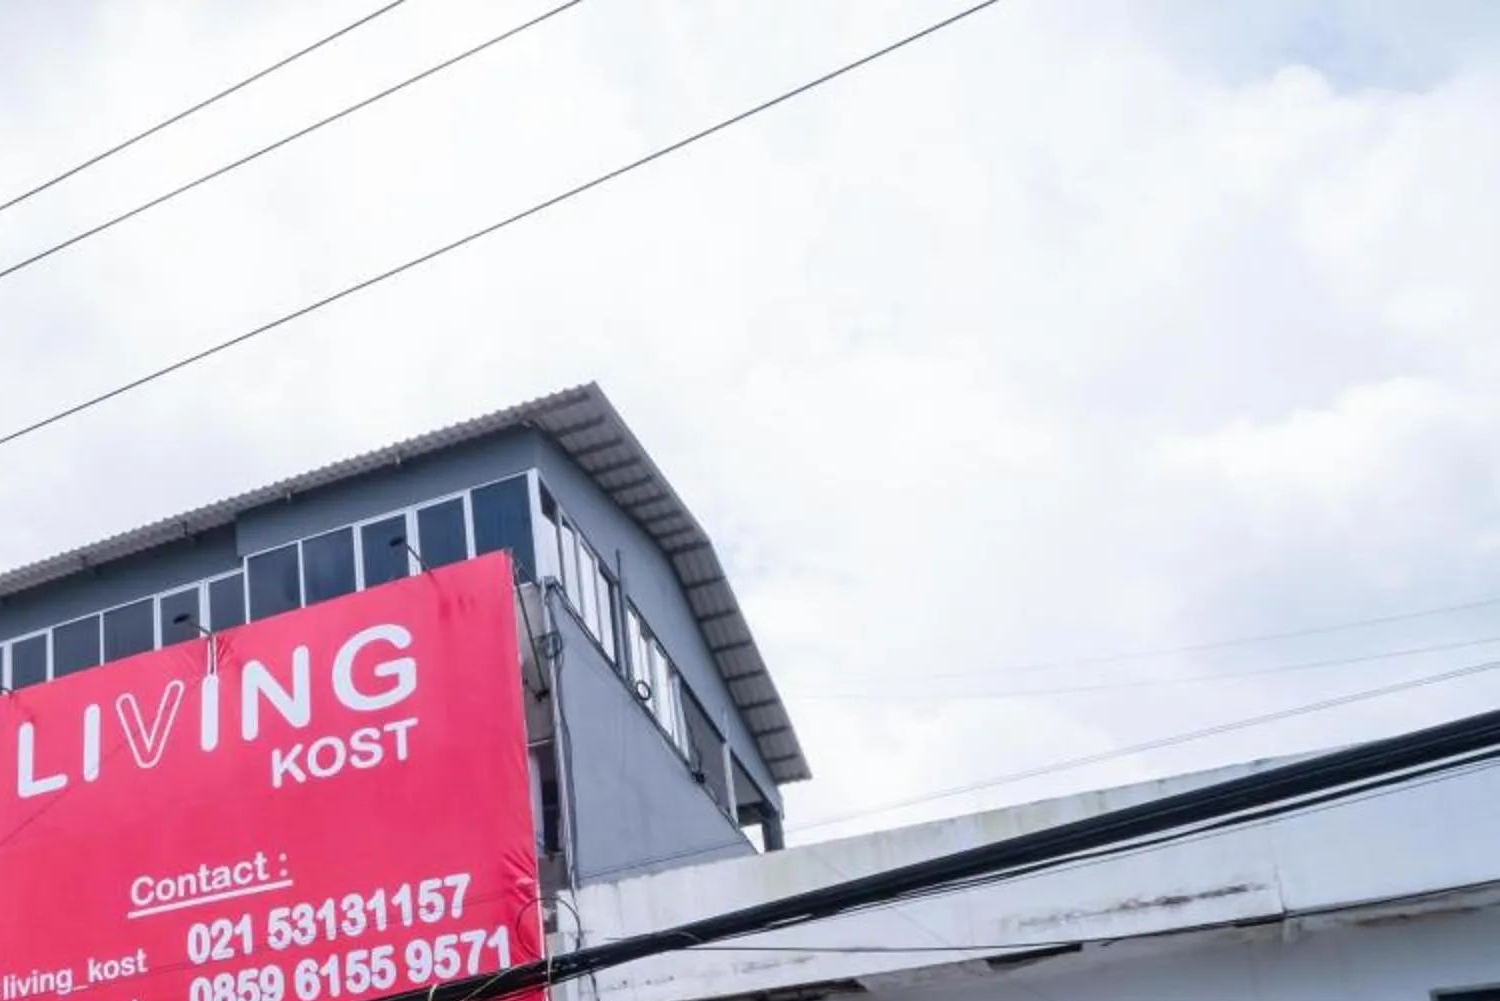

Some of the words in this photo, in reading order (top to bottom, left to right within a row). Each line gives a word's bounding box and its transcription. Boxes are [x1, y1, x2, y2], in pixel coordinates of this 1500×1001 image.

[17, 623, 418, 798] LIVING
[271, 717, 418, 788] KOST
[131, 851, 267, 907] Contact
[187, 918, 254, 965] 021
[266, 873, 472, 952] 53131157
[2, 948, 149, 1000] living_kost
[294, 944, 397, 1001] 6155
[405, 925, 512, 984] 9571
